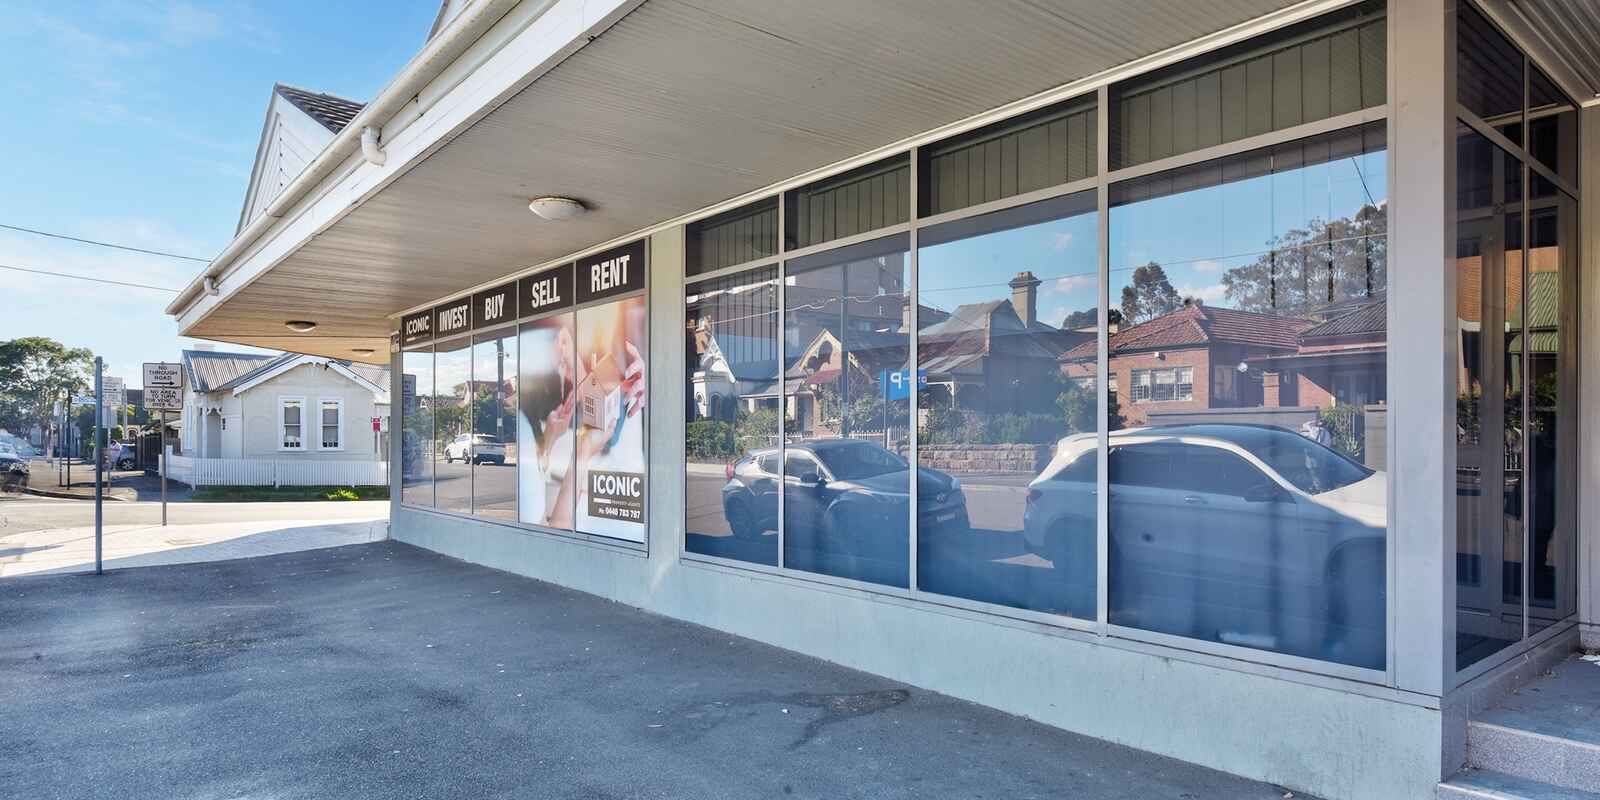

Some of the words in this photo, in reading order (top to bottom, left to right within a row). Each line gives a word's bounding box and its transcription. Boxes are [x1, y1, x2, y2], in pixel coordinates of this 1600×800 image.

[591, 254, 630, 293] RENT
[531, 277, 561, 308] SELL
[439, 304, 468, 332] INVEST
[484, 293, 505, 321] BUY
[405, 315, 430, 335] ICONIC
[593, 474, 641, 498] ICONIC
